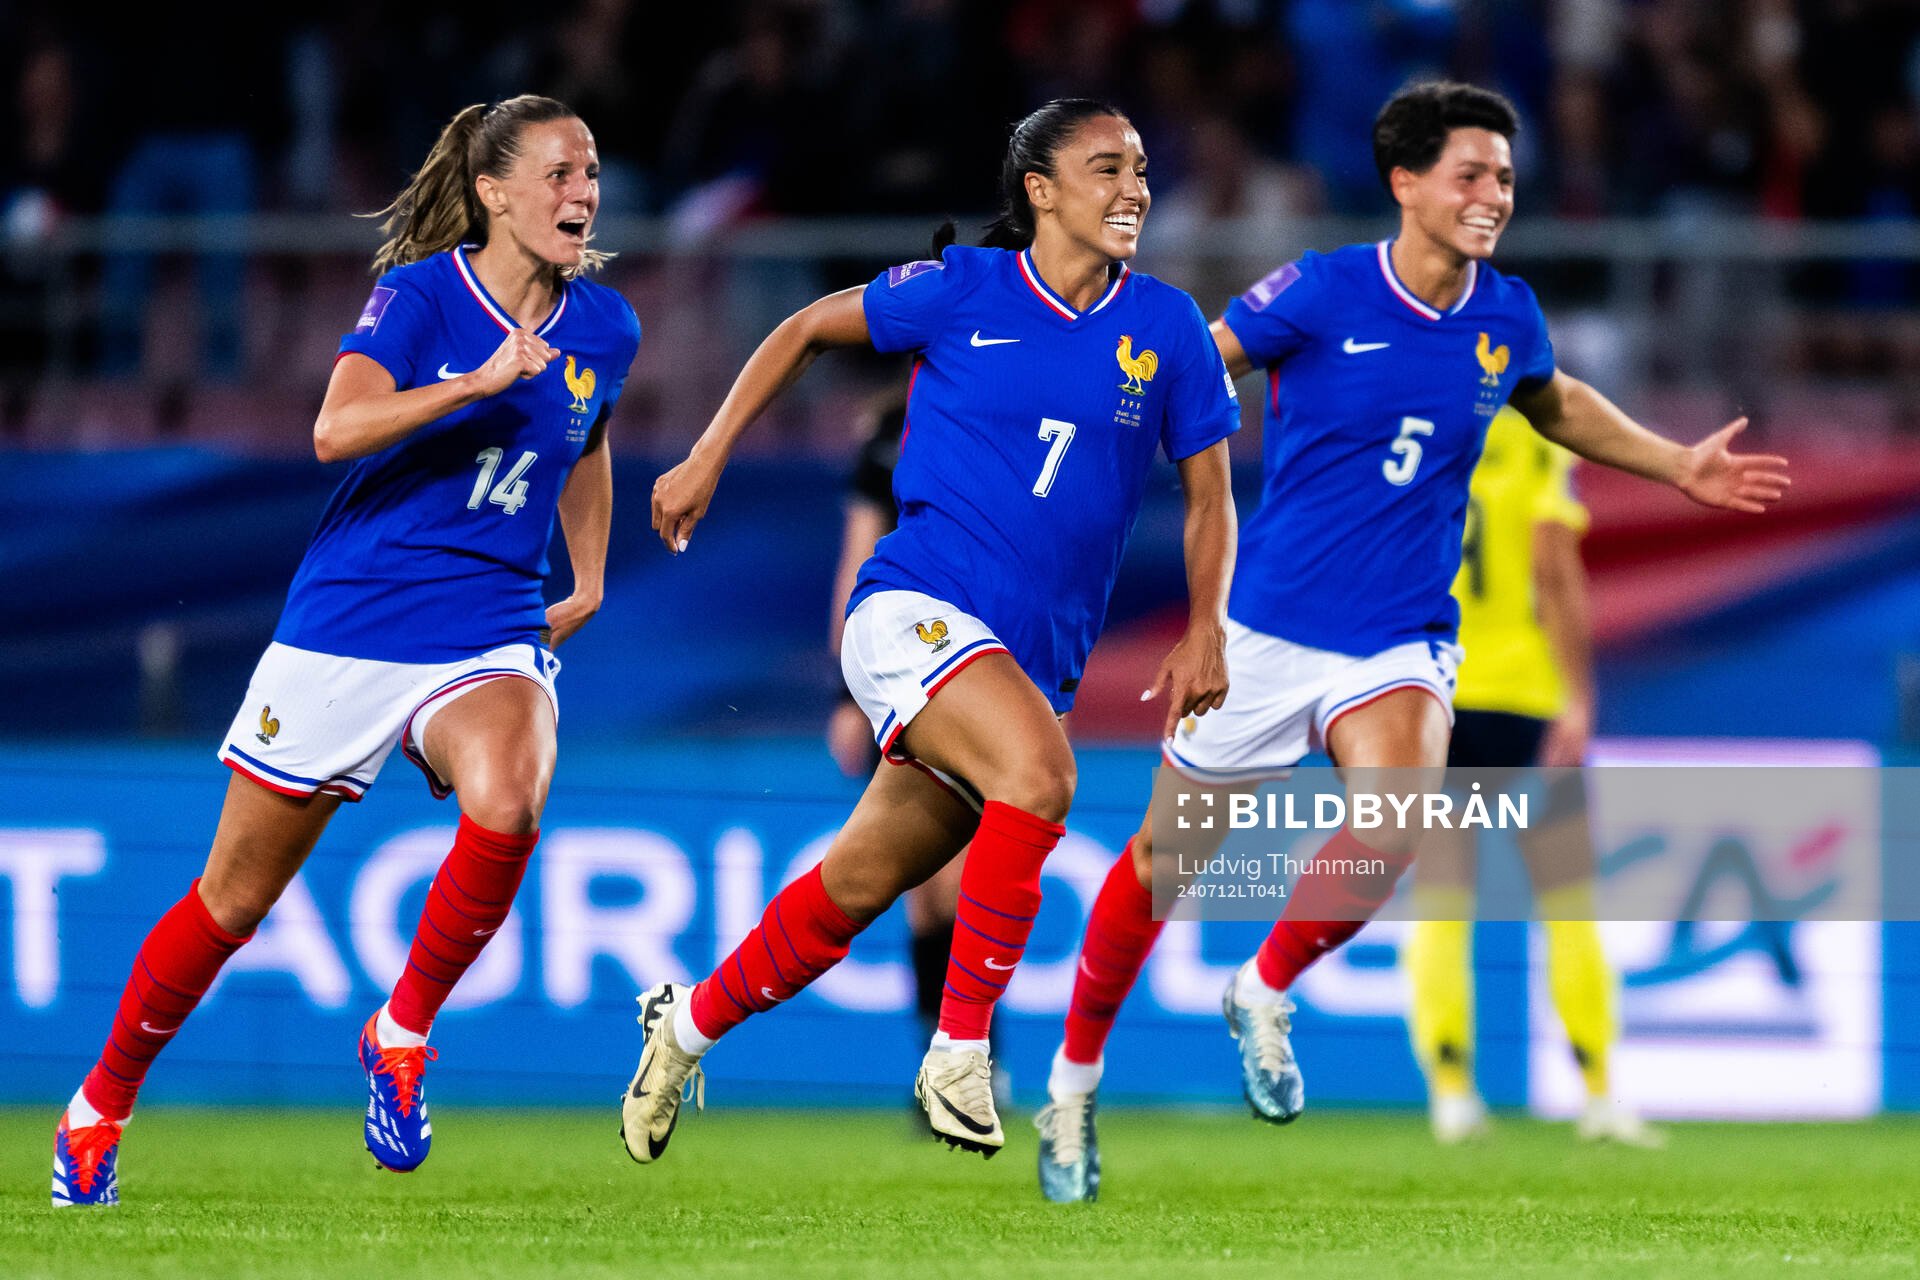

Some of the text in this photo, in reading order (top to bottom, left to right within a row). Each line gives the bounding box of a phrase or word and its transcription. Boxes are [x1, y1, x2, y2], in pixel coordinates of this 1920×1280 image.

[466, 447, 538, 515] 14
[1032, 417, 1077, 498] 7
[1382, 416, 1435, 486] 5
